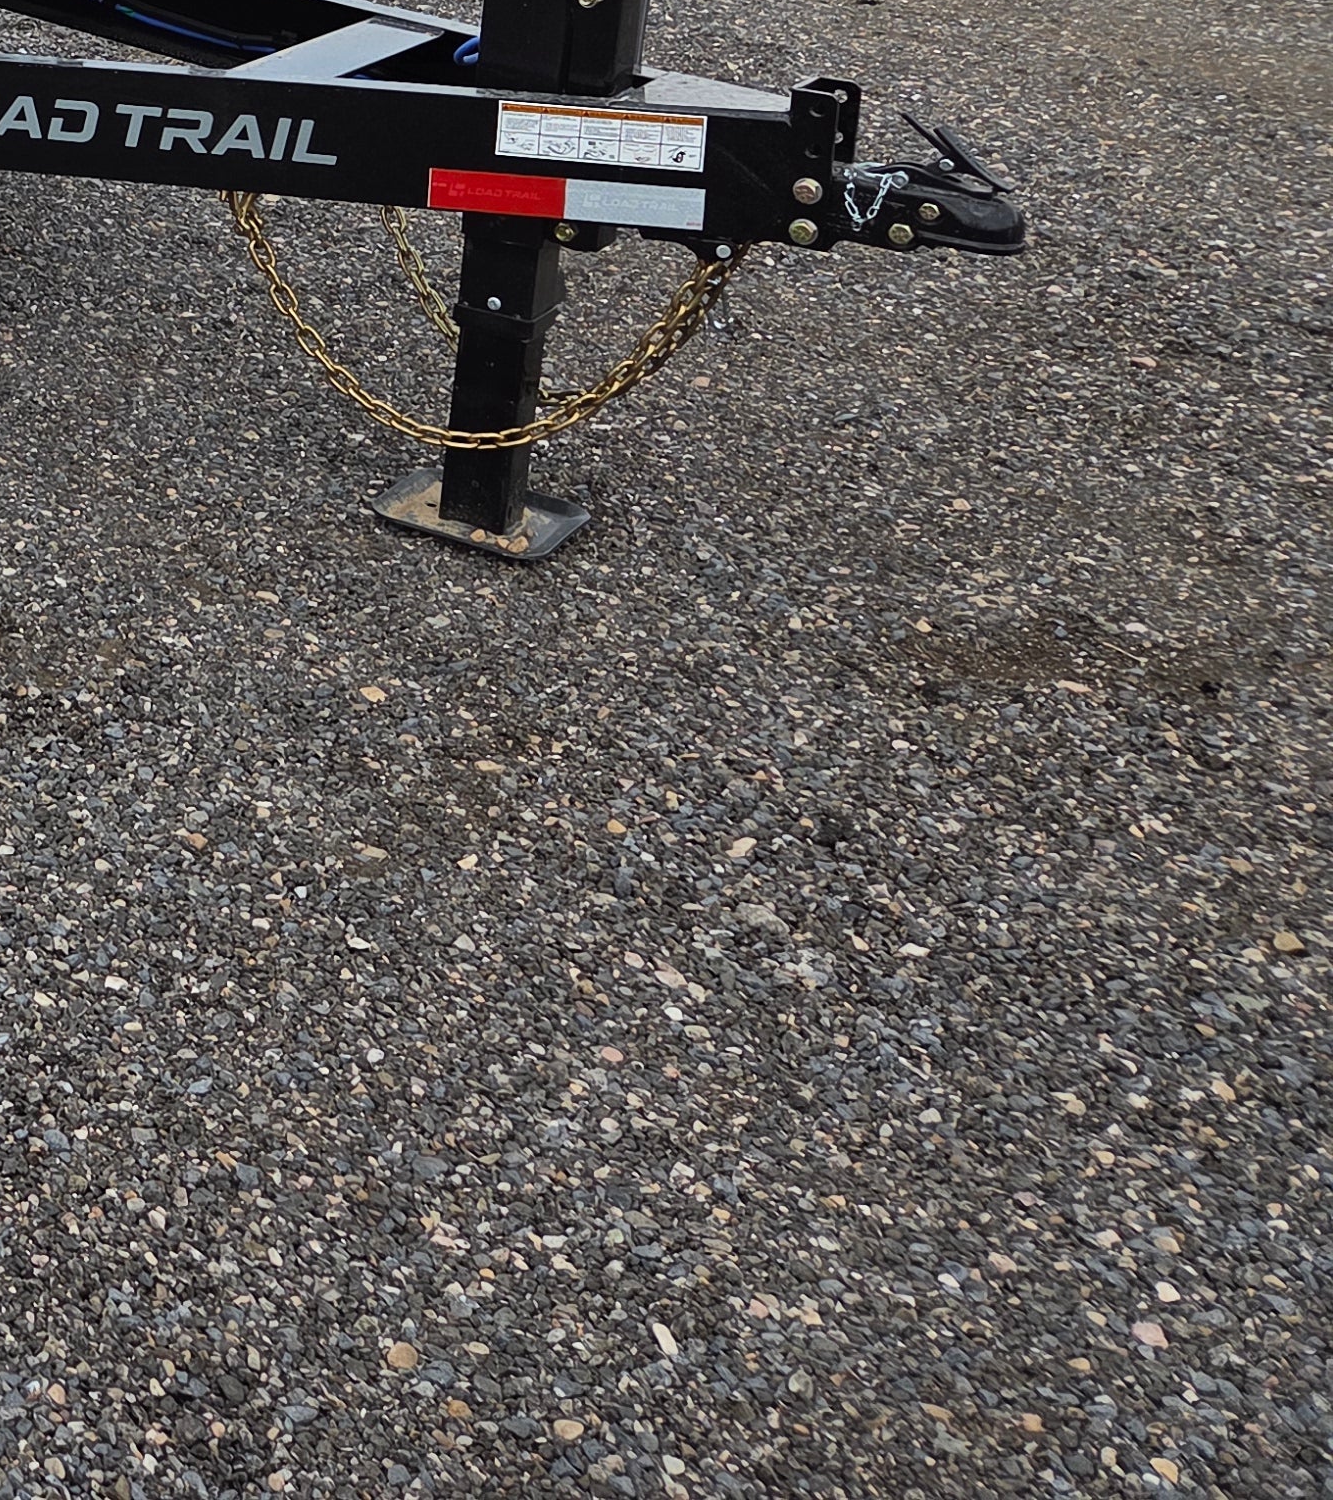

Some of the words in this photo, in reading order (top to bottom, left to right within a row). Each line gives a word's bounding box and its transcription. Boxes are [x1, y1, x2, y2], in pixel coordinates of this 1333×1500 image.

[115, 103, 338, 166] TRAIL
[467, 187, 503, 197] LOAD
[505, 190, 541, 200] TRAIL
[603, 196, 639, 209] LOAD
[640, 200, 679, 212] TRAIL
